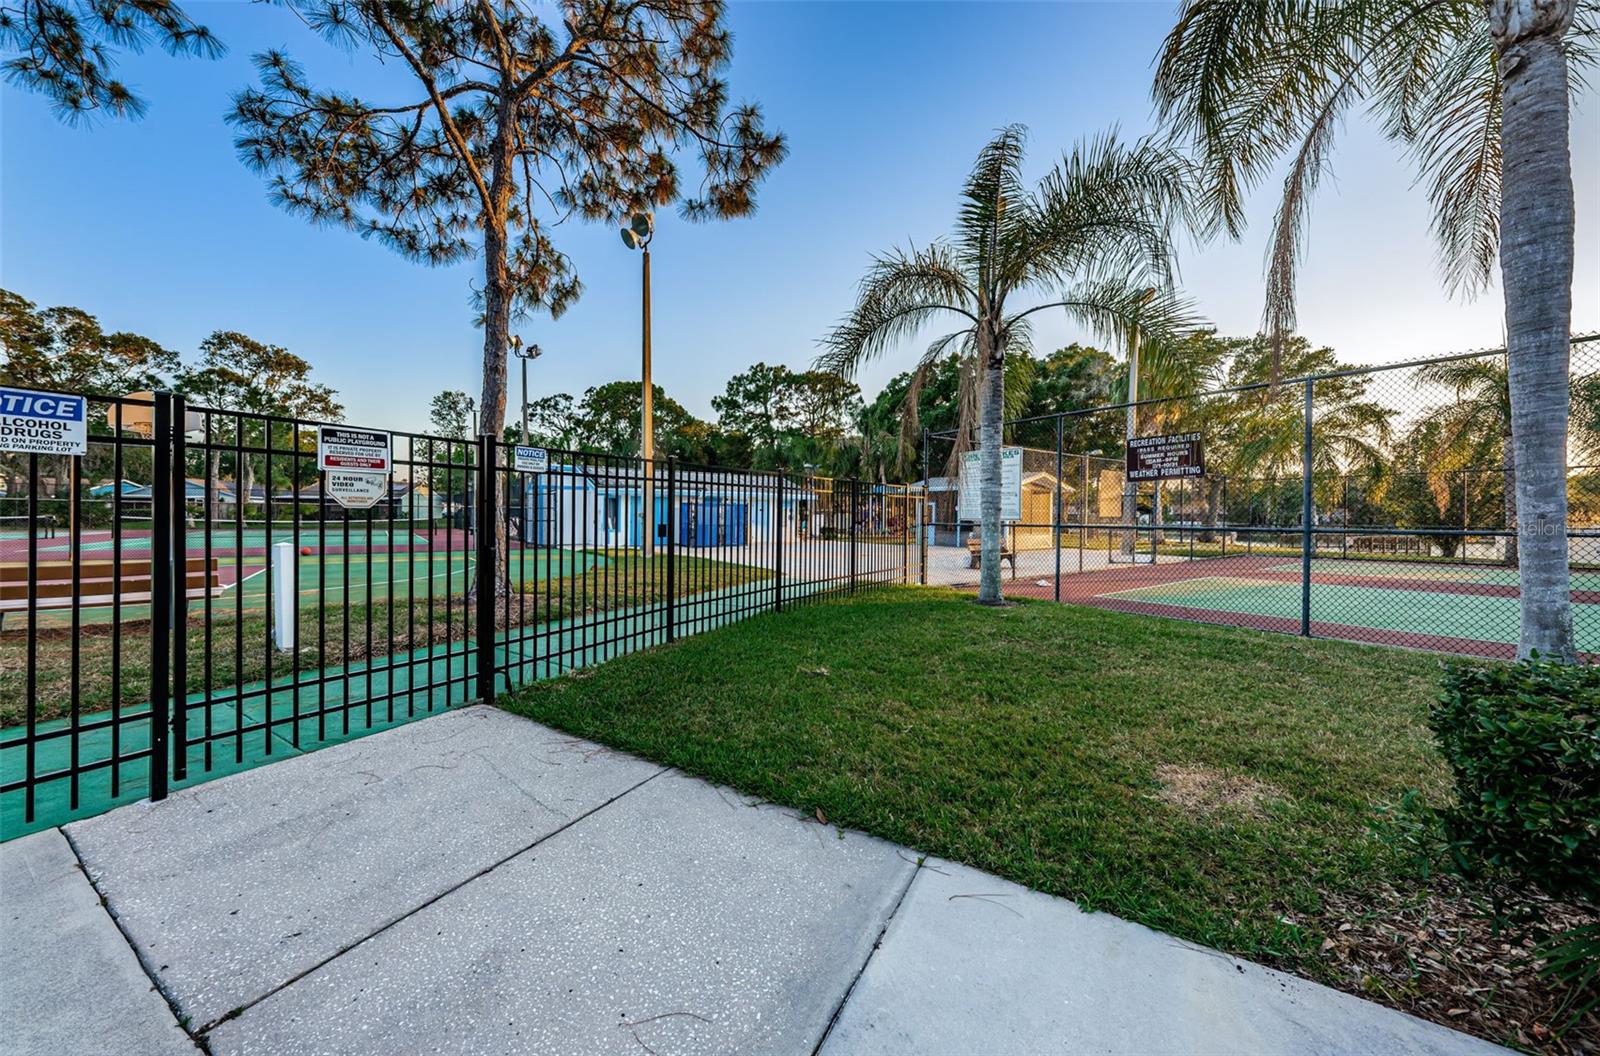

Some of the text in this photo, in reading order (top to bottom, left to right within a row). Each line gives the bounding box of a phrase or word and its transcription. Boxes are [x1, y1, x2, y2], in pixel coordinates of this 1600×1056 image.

[0, 395, 77, 417] TICE
[0, 417, 72, 431] LCOHOL
[1, 427, 62, 439] DRUGS
[29, 439, 81, 448] PROPERTY
[348, 438, 386, 447] PLAYGROUND
[1130, 433, 1200, 447] RECREATION FACILITIES
[518, 449, 544, 457] NOTICE
[1129, 466, 1200, 478] WEATHER PERMITTING
